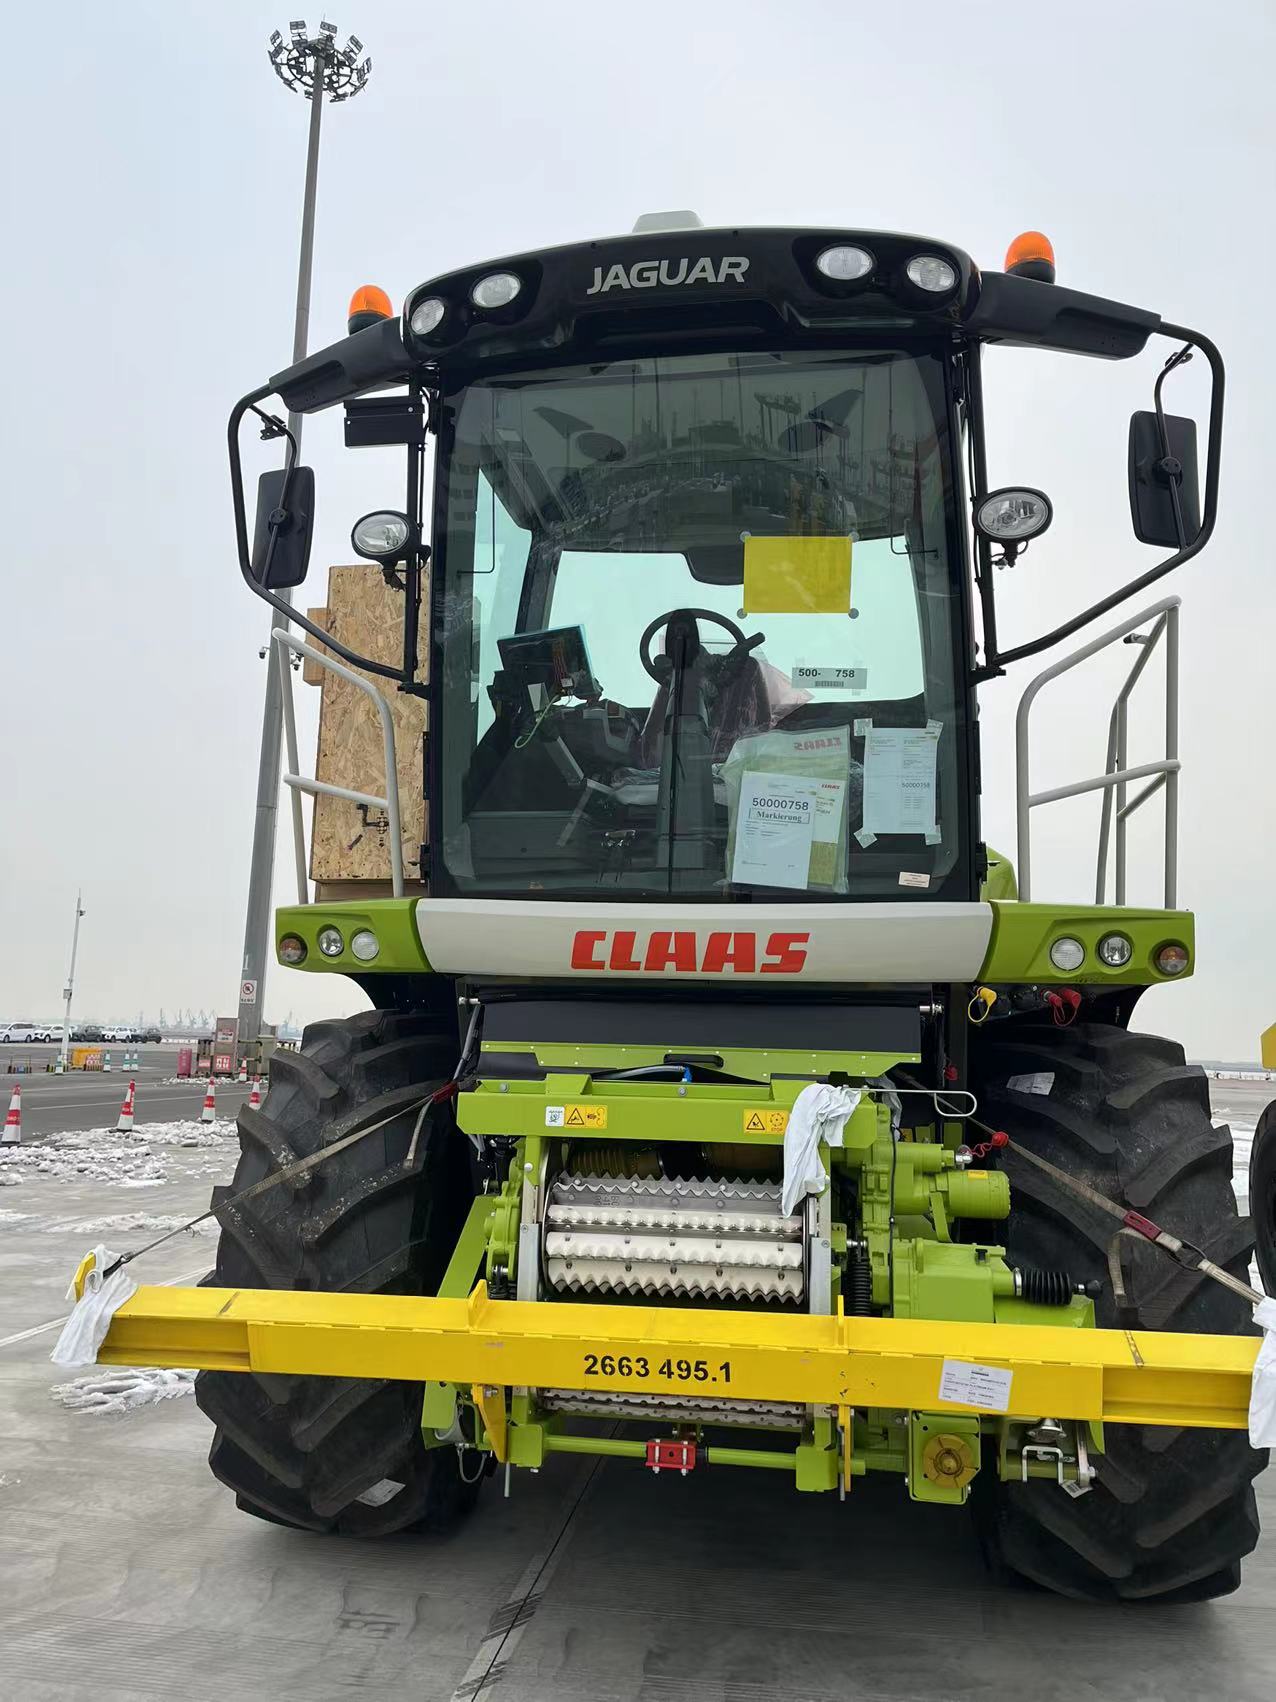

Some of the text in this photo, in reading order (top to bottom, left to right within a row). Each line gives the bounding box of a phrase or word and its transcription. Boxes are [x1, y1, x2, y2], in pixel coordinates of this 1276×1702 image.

[586, 256, 750, 295] JAGUAR
[798, 668, 855, 678] 500- 758
[752, 797, 809, 811] 50000758
[757, 810, 803, 824] Markierung
[570, 930, 811, 974] CLAAS
[583, 1353, 732, 1383] 2663 495.1
